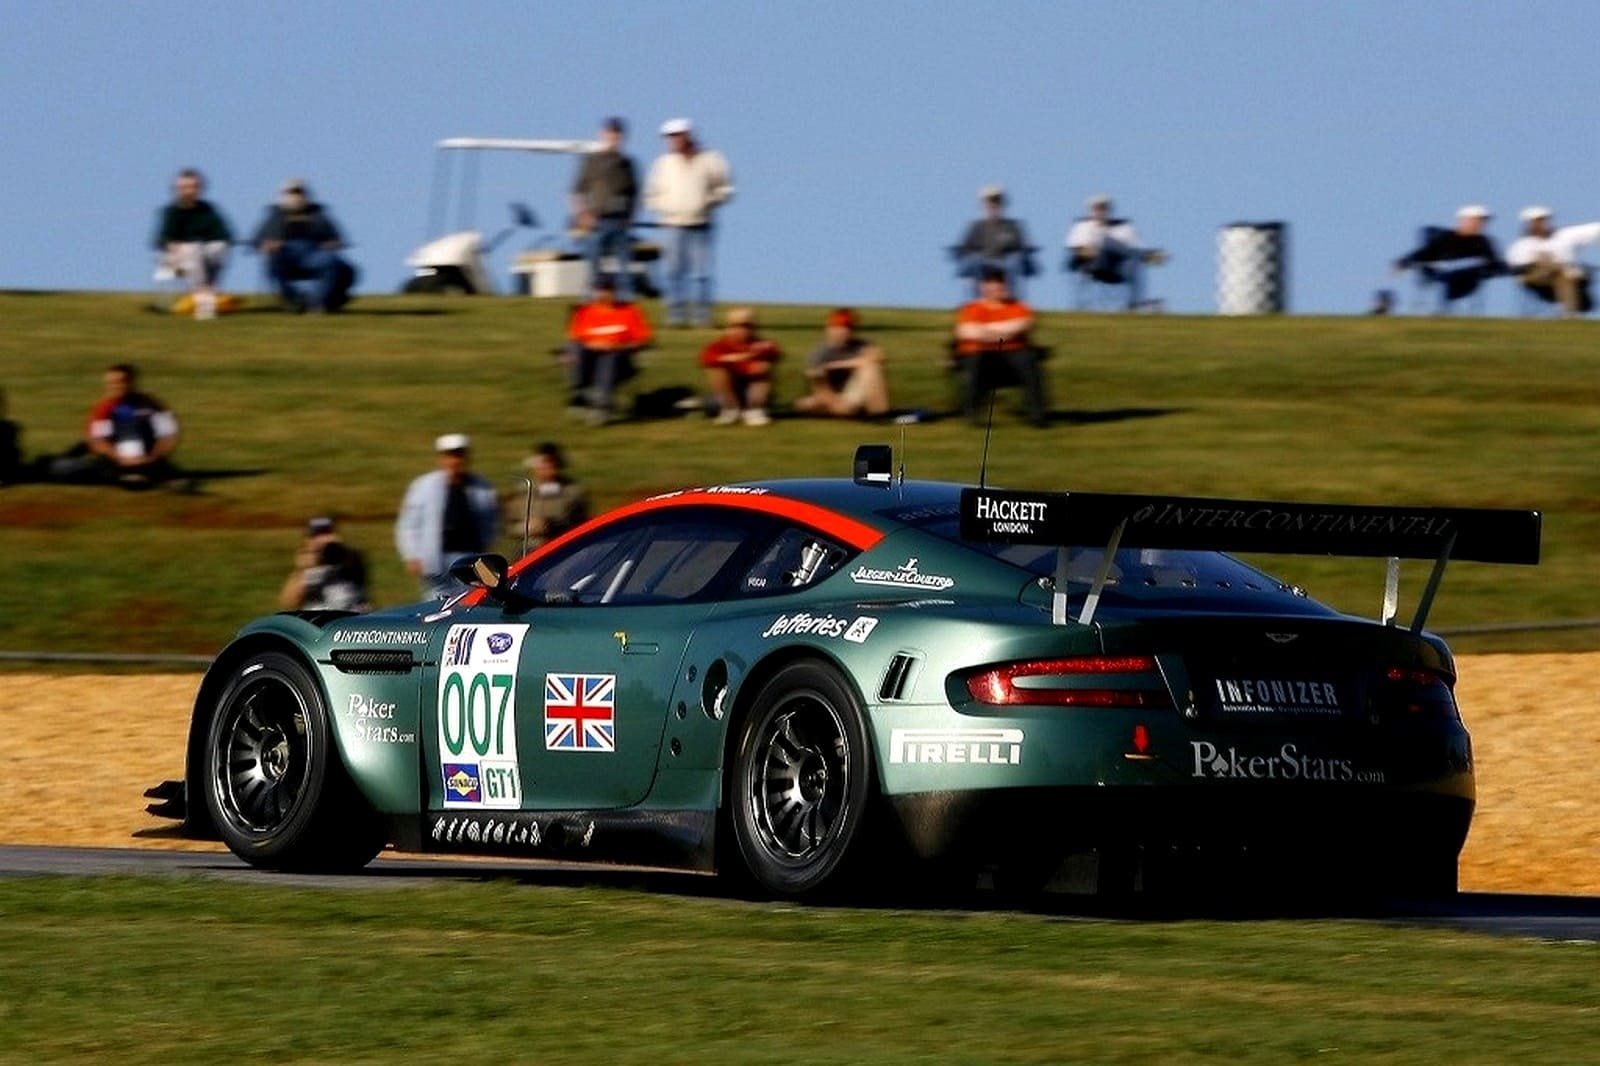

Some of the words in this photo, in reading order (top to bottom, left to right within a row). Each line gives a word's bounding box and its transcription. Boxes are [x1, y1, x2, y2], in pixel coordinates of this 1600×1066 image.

[976, 496, 1048, 521] HACKETT
[1153, 503, 1457, 536] INTERCONTINENTAL
[339, 629, 428, 646] INTERCONTINENTAL
[761, 613, 848, 638] Jefferies
[1215, 678, 1340, 706] INFONIZER
[442, 671, 512, 757] 007
[889, 728, 1024, 765] PIRELLI
[448, 777, 478, 789] SUNOCO
[485, 767, 517, 799] GT1
